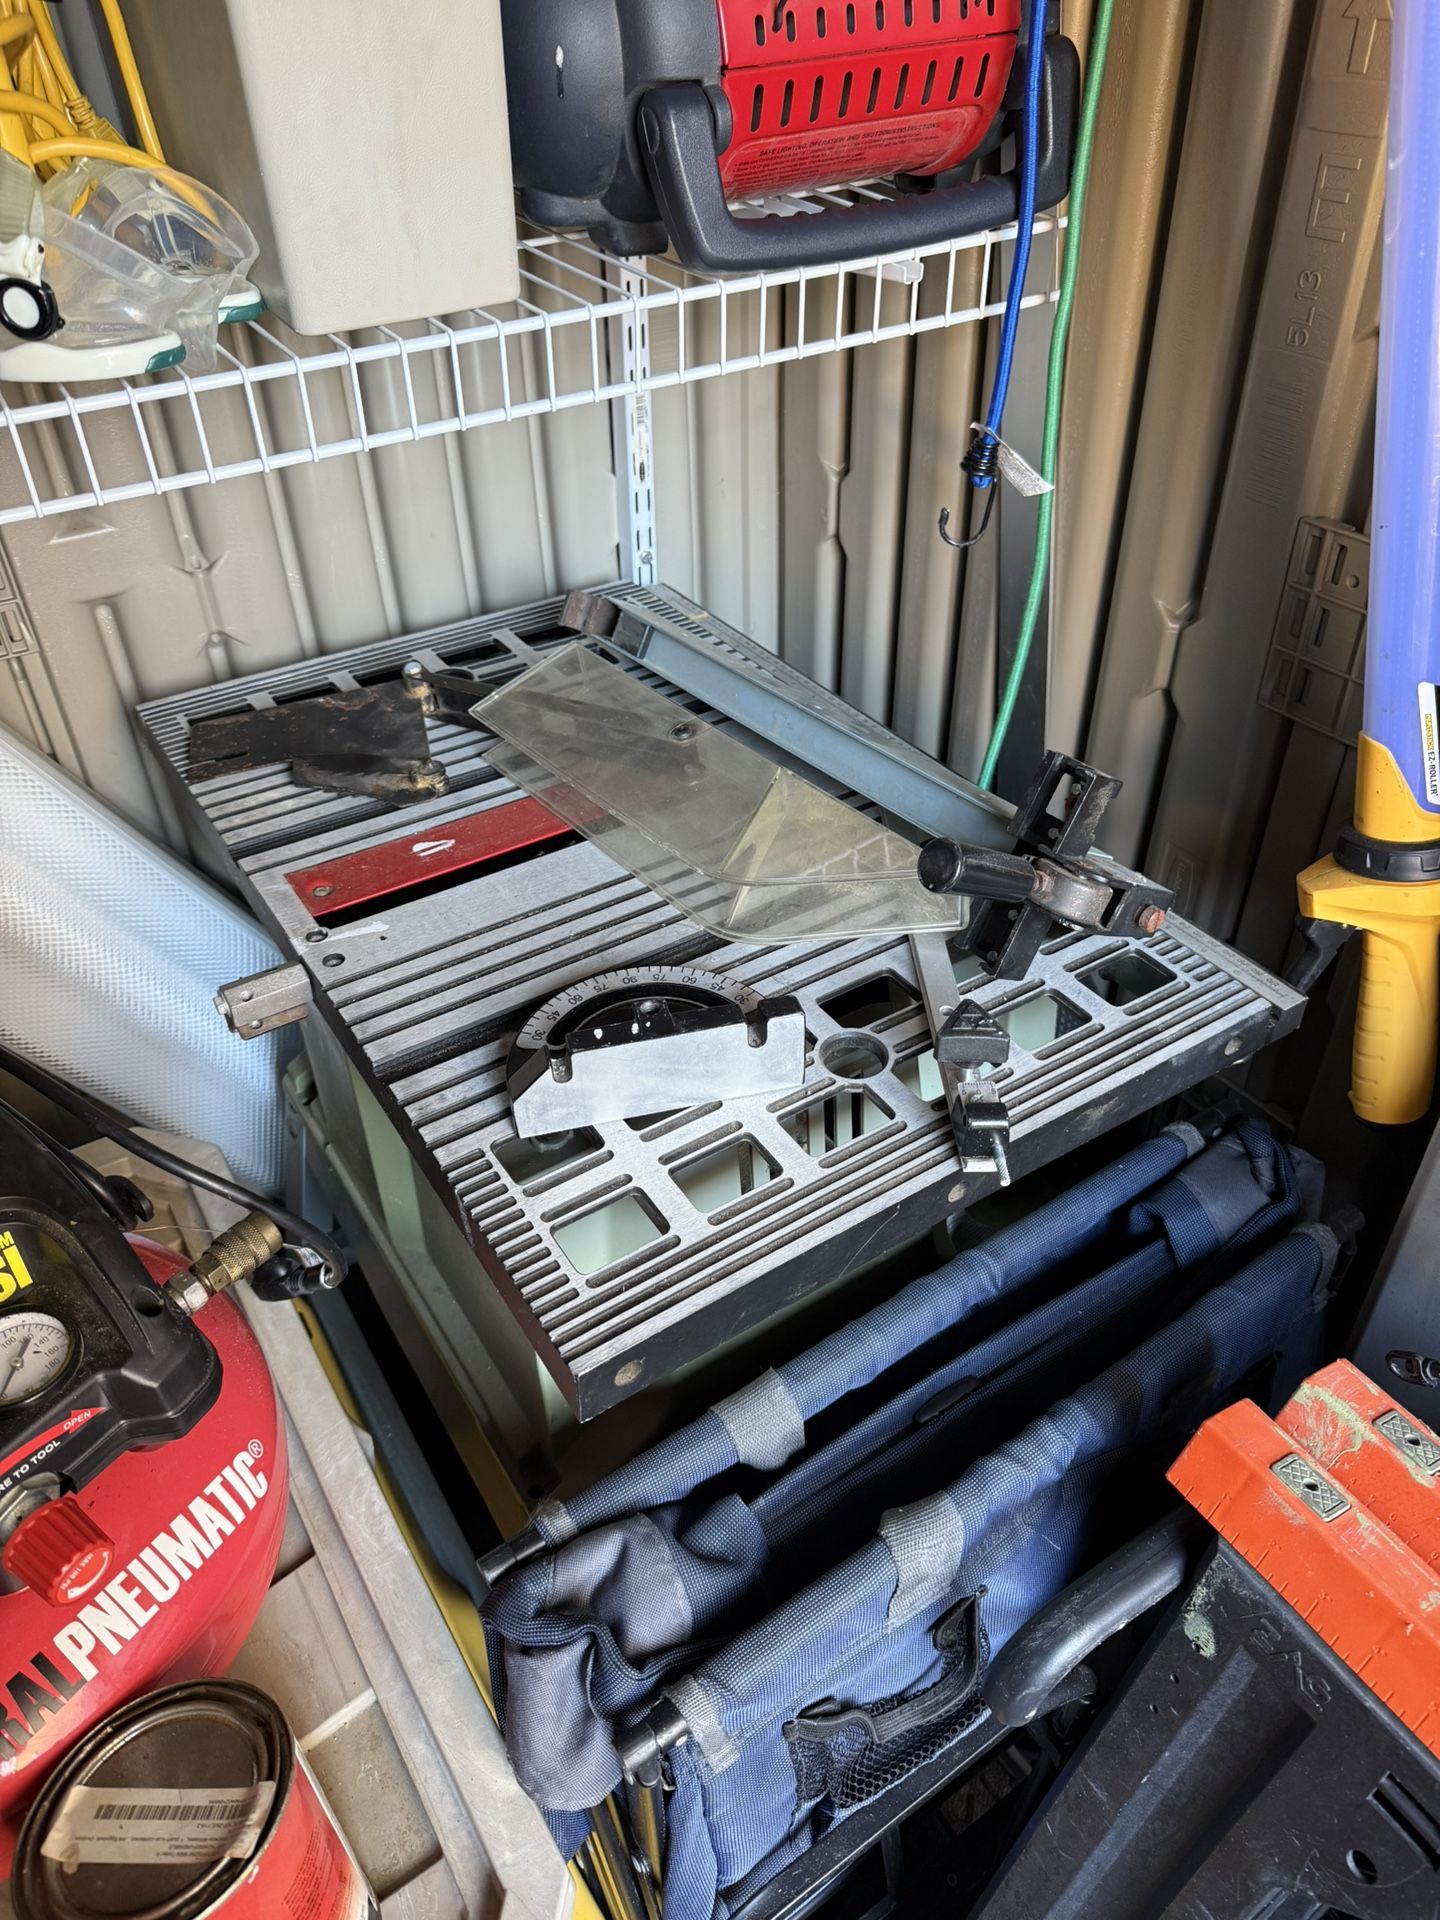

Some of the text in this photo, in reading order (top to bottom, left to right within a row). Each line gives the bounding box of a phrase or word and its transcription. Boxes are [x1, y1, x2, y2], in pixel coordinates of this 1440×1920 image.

[759, 147, 775, 157] SAFE
[1286, 269, 1323, 348] 5L13
[531, 973, 750, 1042] 30 45 60 75 90 75 60 45 30
[1, 1336, 17, 1349] 100
[34, 1335, 50, 1348] 140
[44, 1345, 60, 1358] 160
[45, 1357, 61, 1370] 180
[63, 1410, 91, 1430] OPEN
[13, 1463, 30, 1478] TO
[30, 1440, 61, 1464] TOOL
